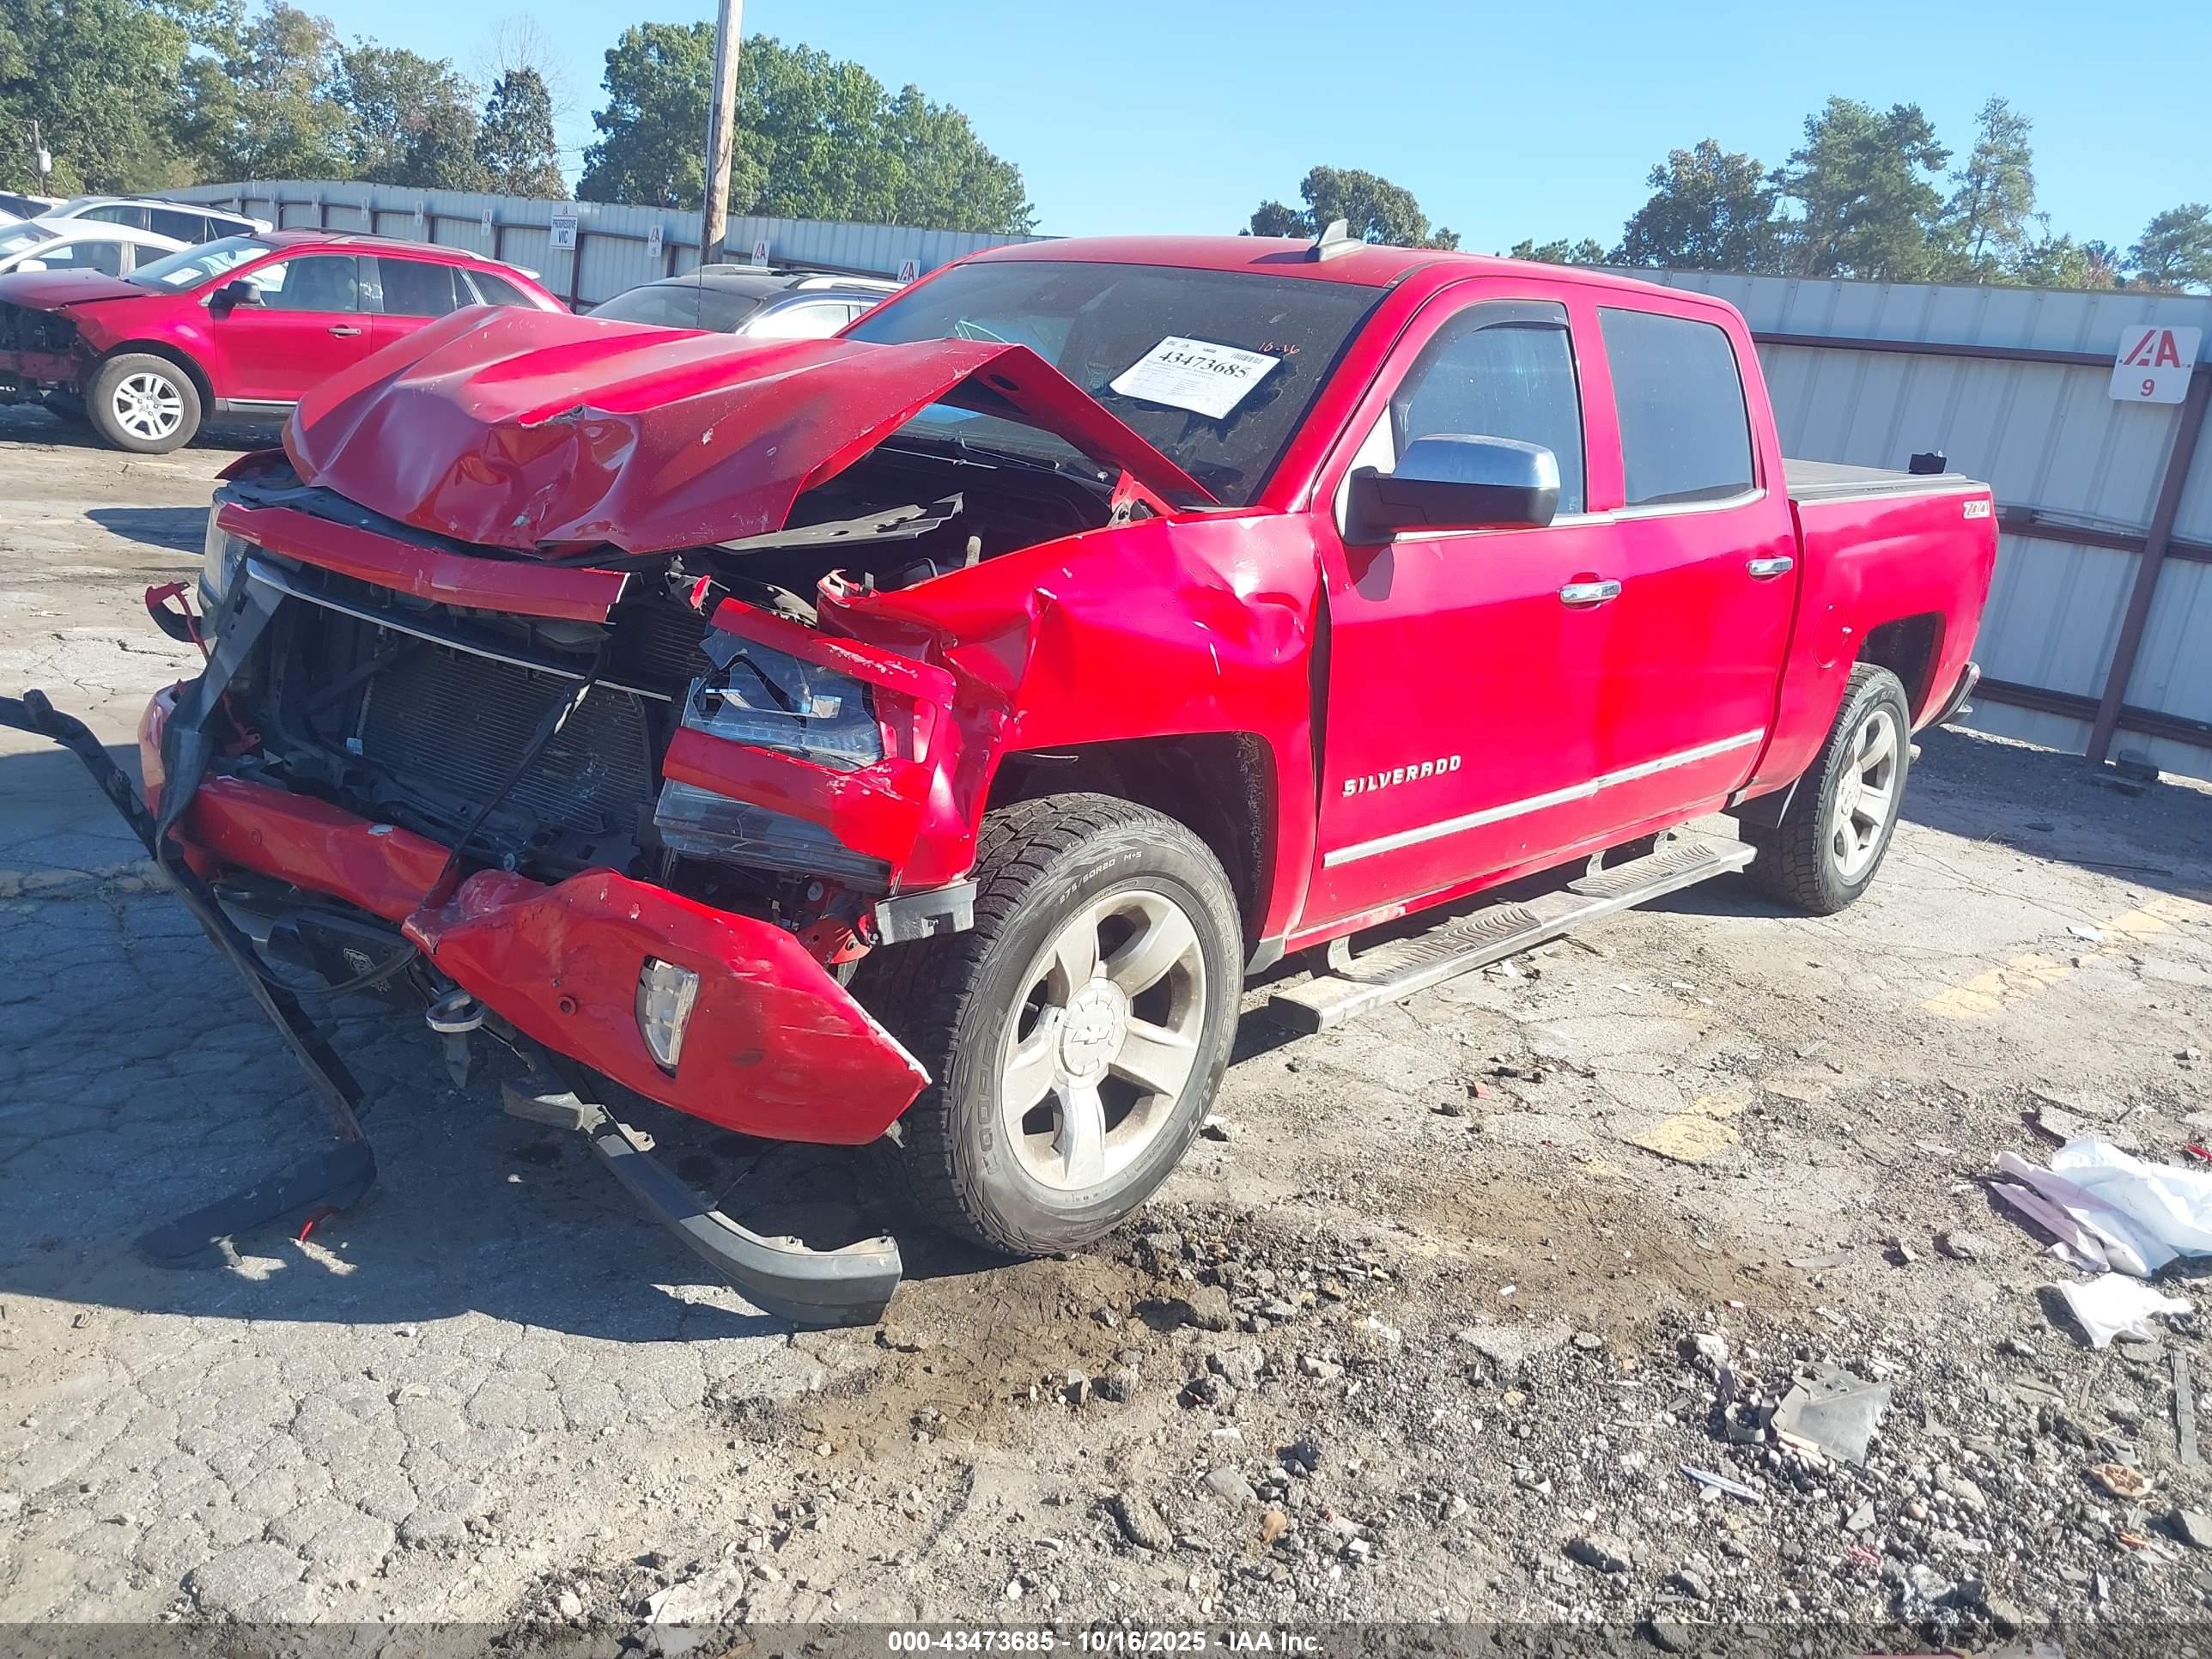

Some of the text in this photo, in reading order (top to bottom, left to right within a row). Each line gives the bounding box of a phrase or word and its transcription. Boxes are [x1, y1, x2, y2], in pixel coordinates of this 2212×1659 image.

[558, 230, 568, 244] VIC
[1158, 350, 1253, 379] 43473685
[2141, 379, 2155, 396] 9
[1342, 755, 1462, 797] SILVERADO
[1123, 851, 1142, 861] M+S
[1197, 879, 1237, 1062] DISCOVERER
[977, 1006, 1008, 1176] COOPER
